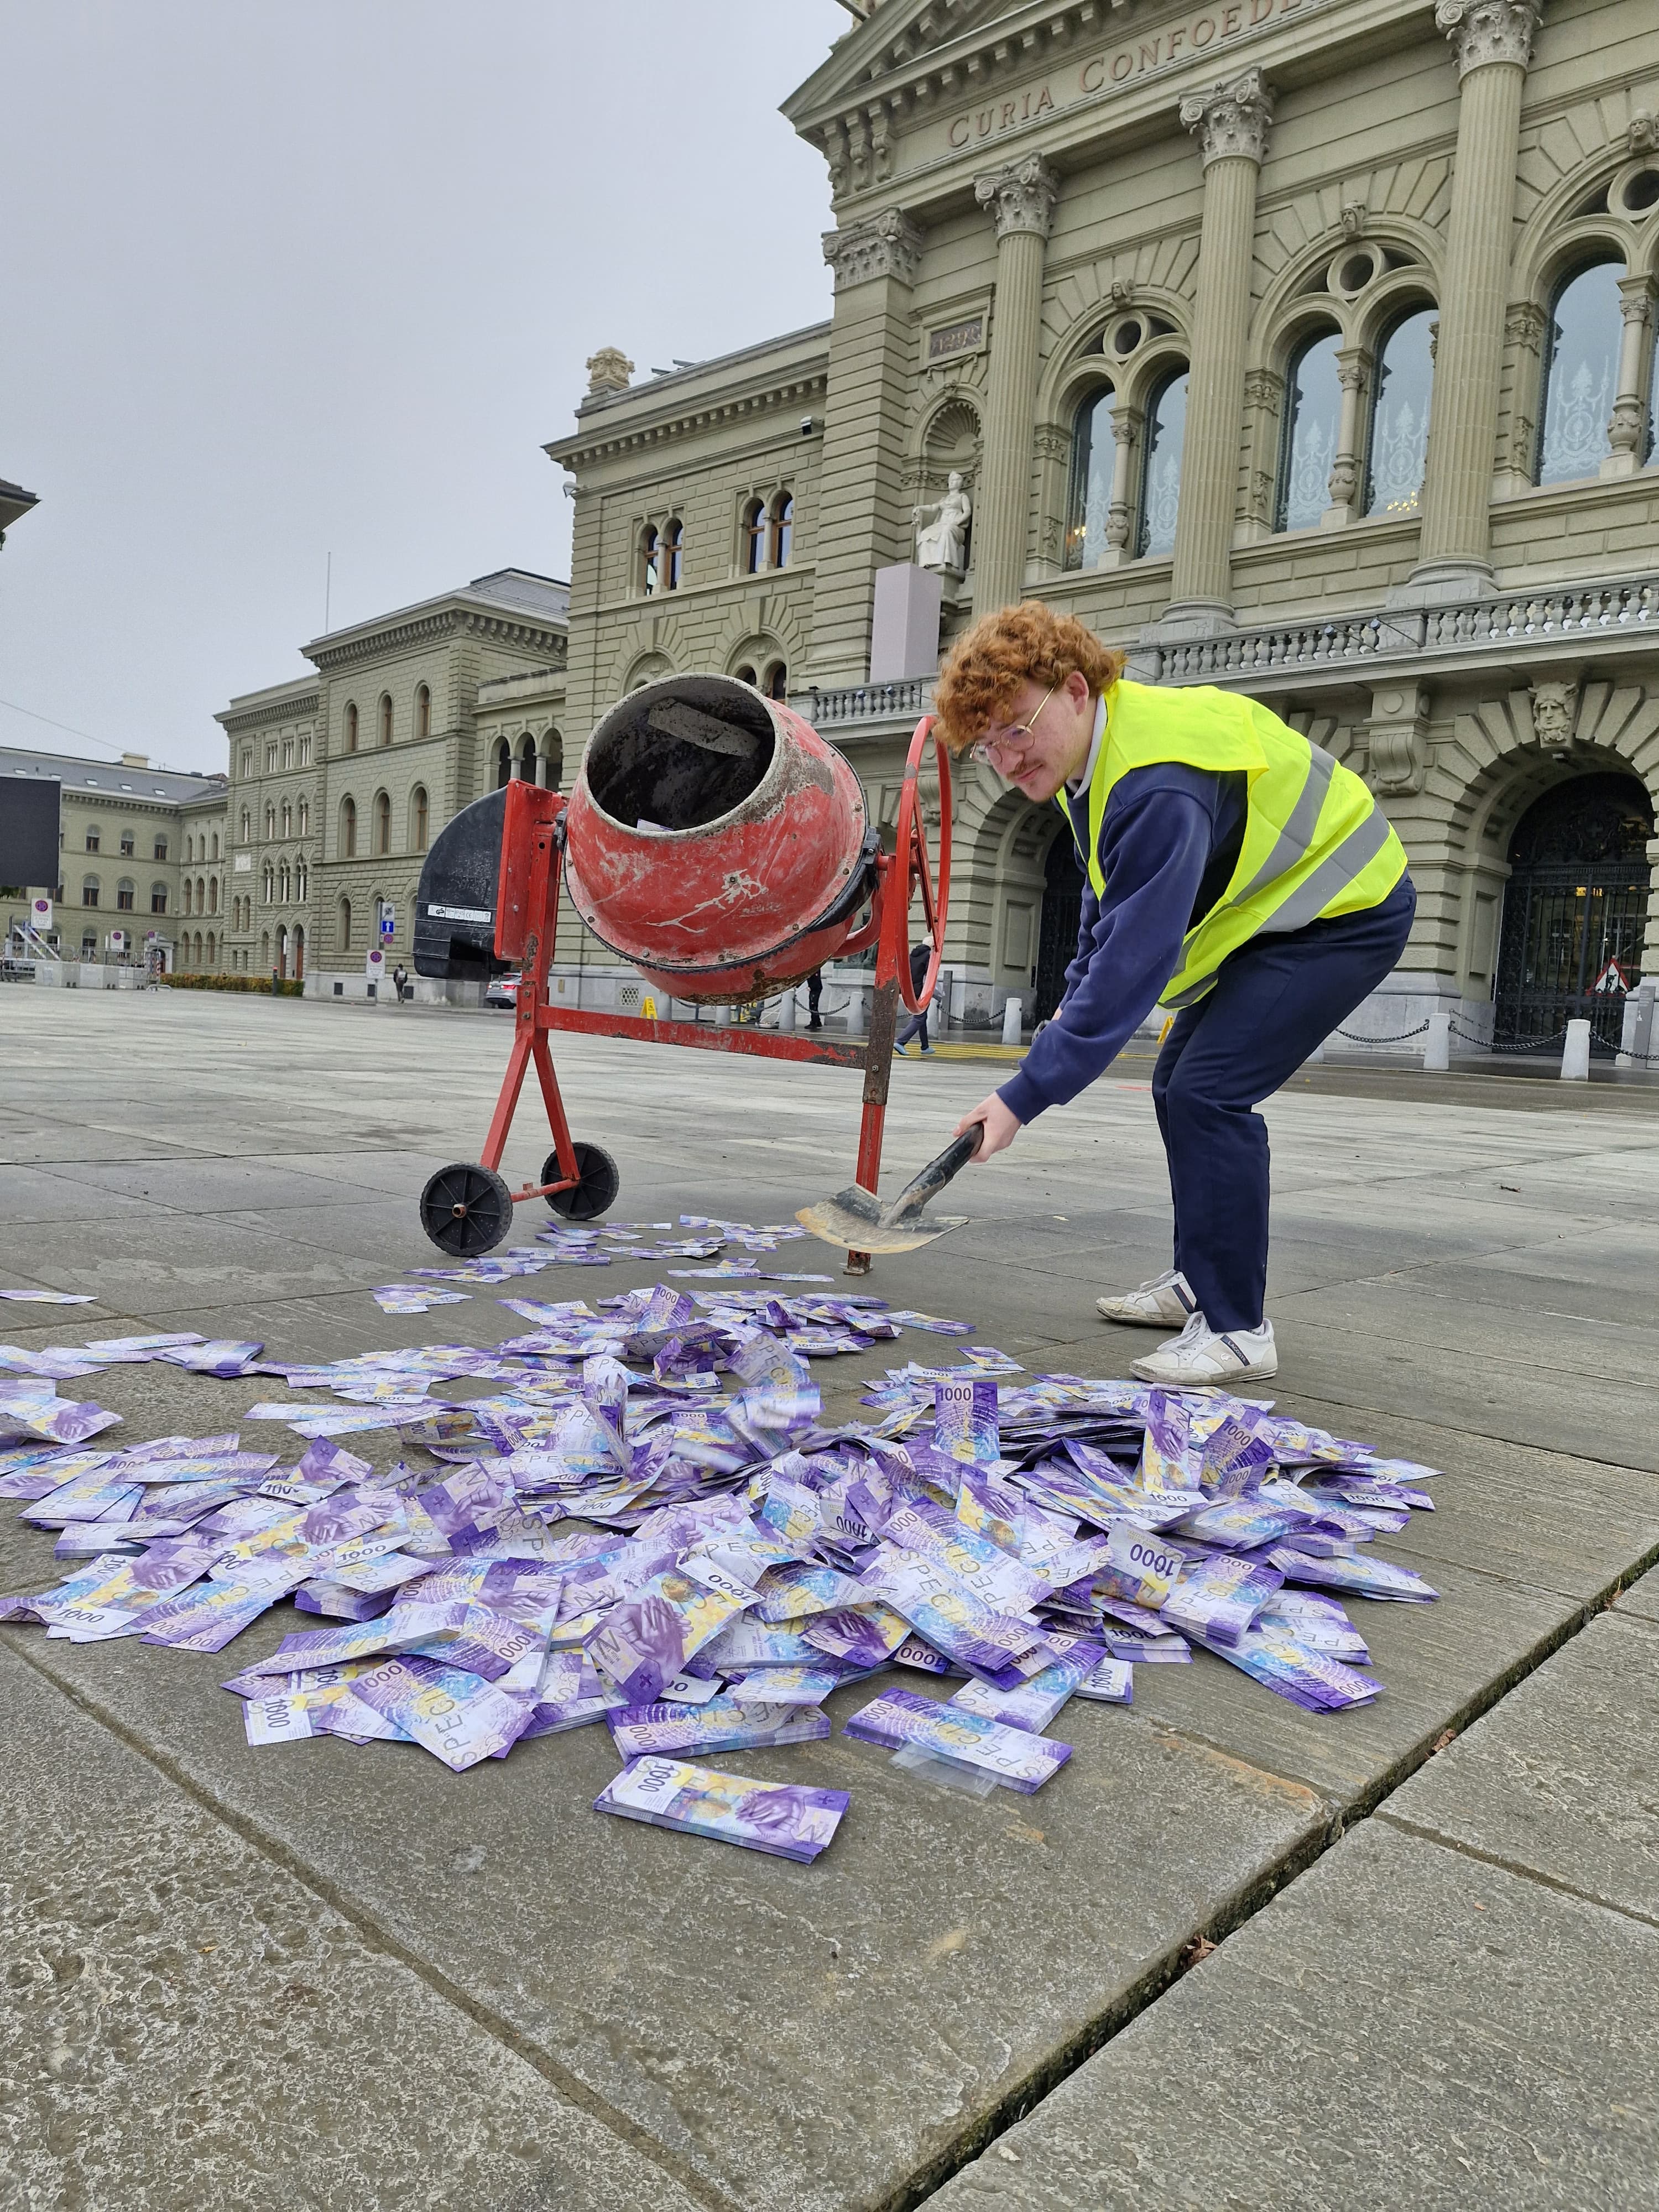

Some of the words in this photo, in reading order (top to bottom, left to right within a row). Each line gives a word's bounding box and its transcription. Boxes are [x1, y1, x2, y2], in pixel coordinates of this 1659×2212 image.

[947, 86, 1054, 148] CURIA
[656, 1286, 677, 1303] 1000
[939, 1387, 972, 1402] 1000
[1222, 1421, 1251, 1447] 1000
[1224, 1470, 1249, 1486] 1000
[1149, 1494, 1188, 1503] 1000
[1348, 1494, 1386, 1503] 1000
[886, 1511, 919, 1536] 1000
[341, 1545, 386, 1561] 1000
[1130, 1543, 1175, 1577] 1000
[1213, 1555, 1253, 1571] 1000
[708, 1574, 756, 1601] 1000
[55, 1608, 106, 1624] 1000
[150, 1621, 187, 1636] 1000
[998, 1624, 1035, 1647] 1000
[1109, 1628, 1157, 1640] 1000
[499, 1631, 538, 1658] 1000
[900, 1646, 943, 1667] 1000
[358, 1665, 403, 1692] 1000
[1091, 1667, 1113, 1690] 1000
[1339, 1680, 1373, 1695] 1000
[264, 1698, 291, 1729] 1000
[858, 1702, 894, 1724] 1000
[629, 1726, 660, 1752] 1000
[638, 1764, 676, 1793] 1000
